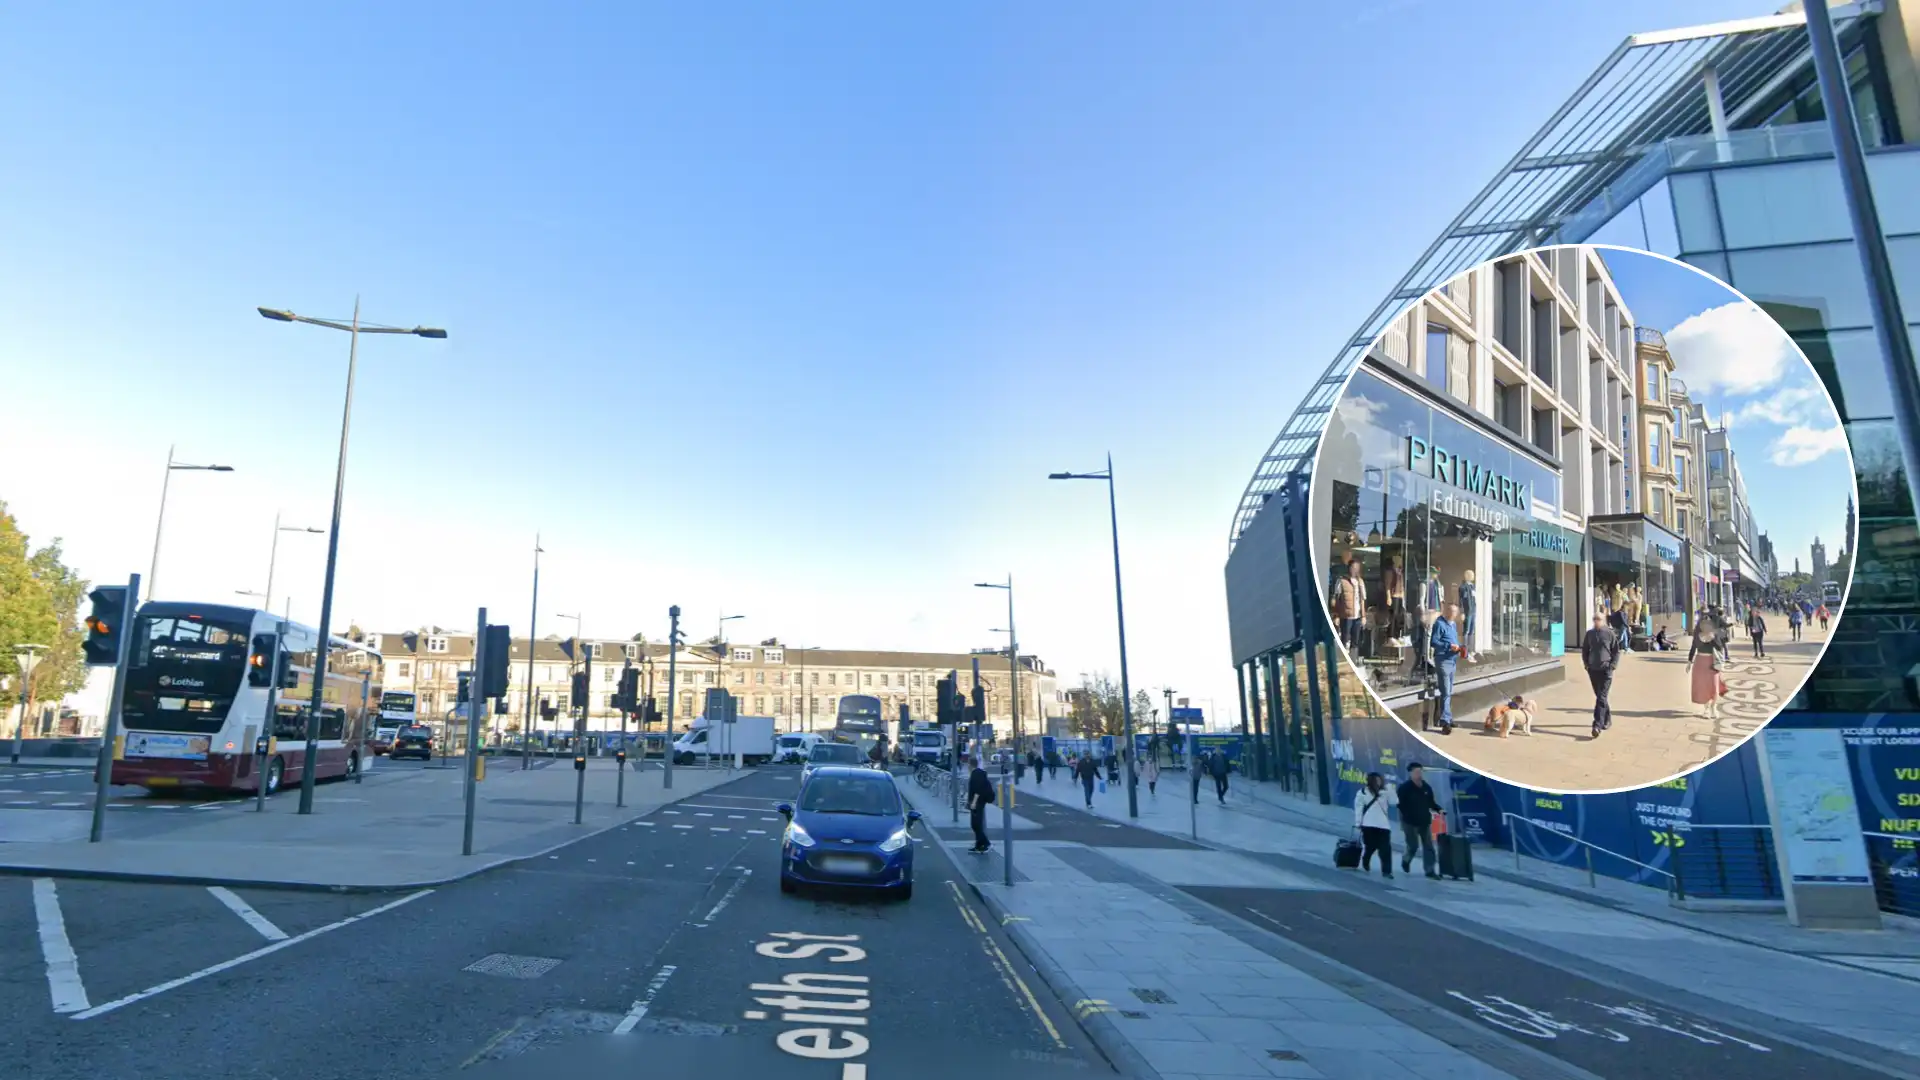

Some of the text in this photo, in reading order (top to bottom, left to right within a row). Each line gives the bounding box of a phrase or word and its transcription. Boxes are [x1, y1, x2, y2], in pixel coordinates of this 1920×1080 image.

[1405, 435, 1527, 511] PRIMARK
[1433, 489, 1509, 531] Edinburgh
[1520, 530, 1570, 554] PRIMARK
[172, 677, 204, 687] Lothian
[1635, 802, 1692, 818] JUST AROUND
[1639, 815, 1657, 827] THE
